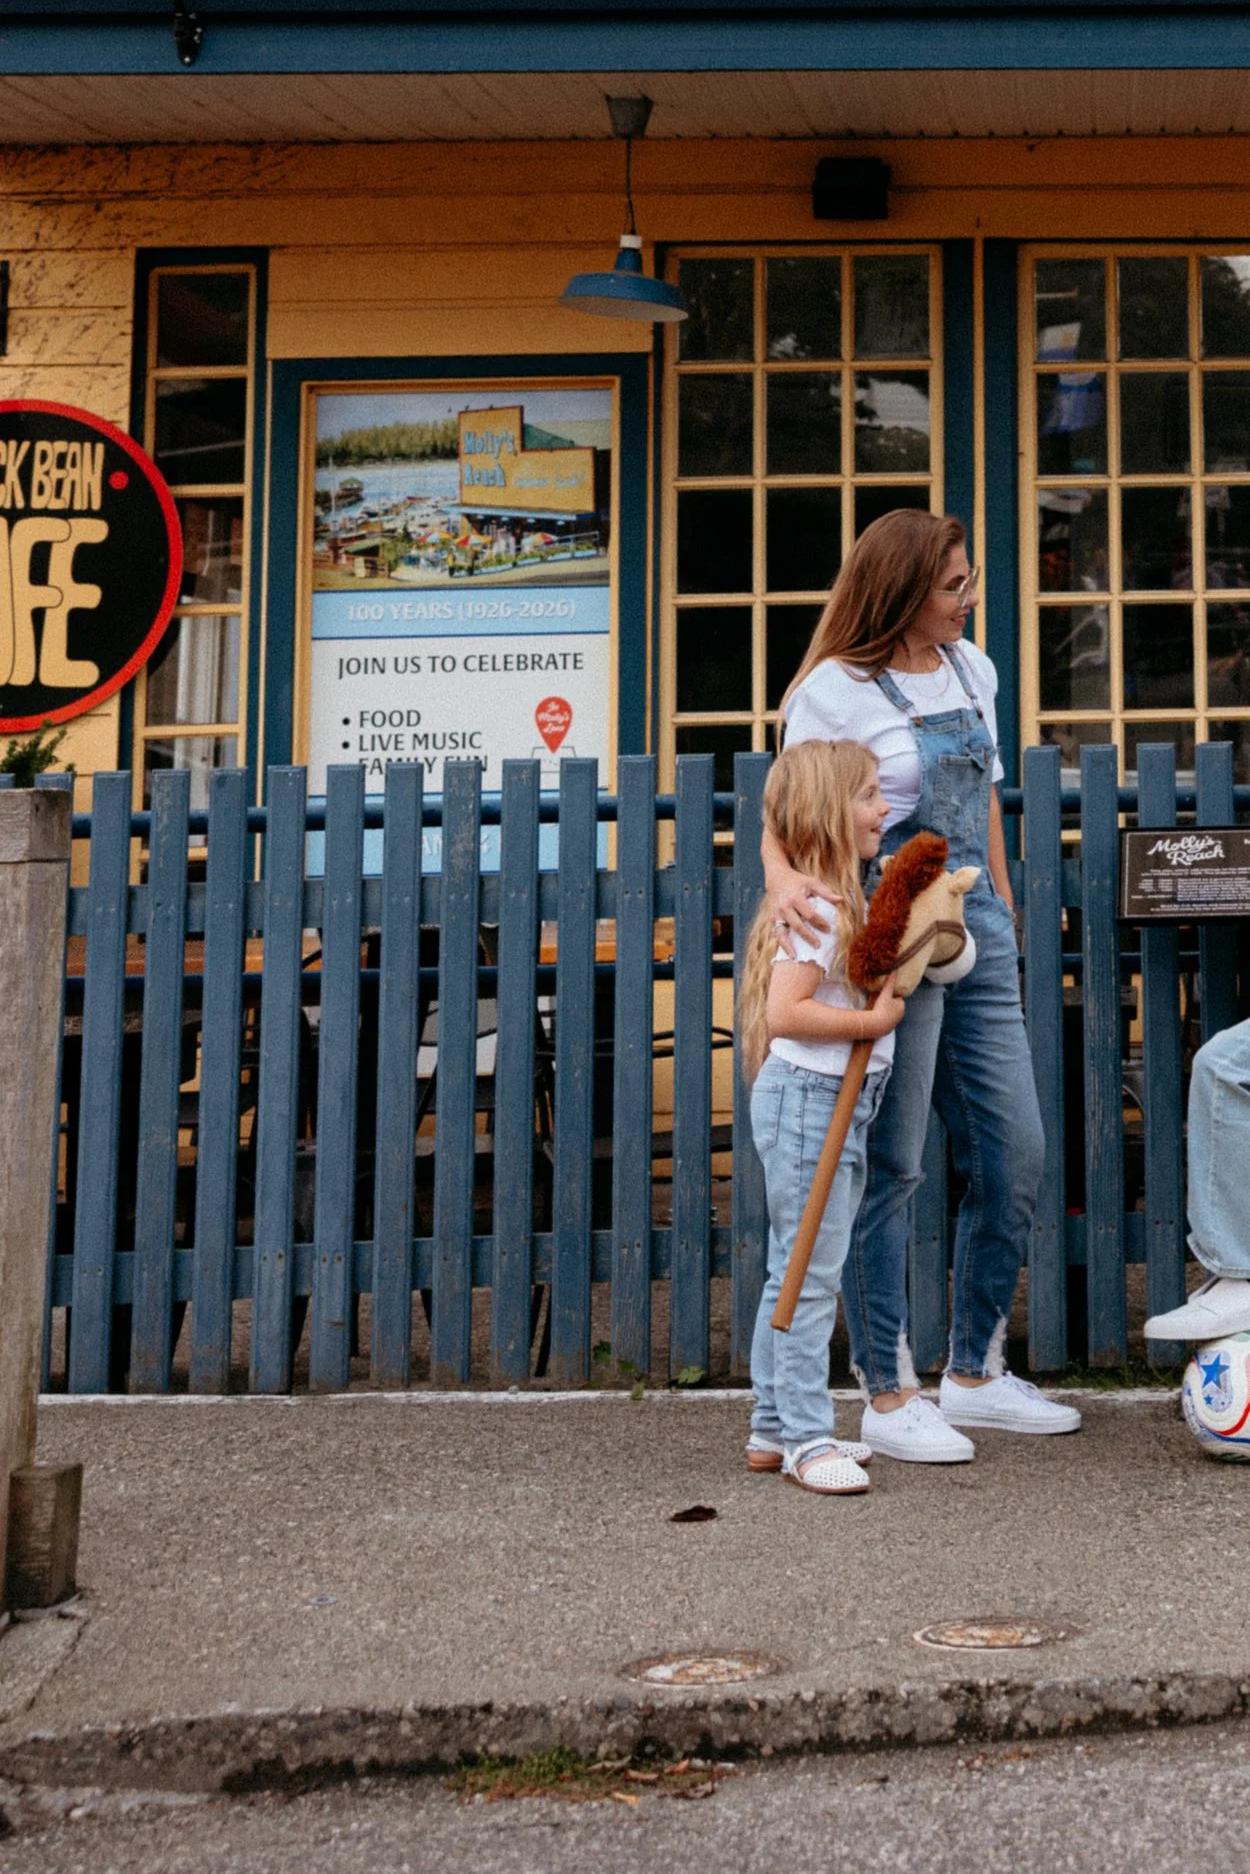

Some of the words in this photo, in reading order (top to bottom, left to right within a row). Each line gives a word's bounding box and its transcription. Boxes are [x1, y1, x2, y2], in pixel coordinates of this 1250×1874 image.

[30, 440, 105, 511] BEAN
[349, 605, 384, 622] 100
[390, 601, 454, 621] YEARS
[458, 597, 577, 621] (1926-2026)
[338, 657, 387, 679] JOIN
[394, 656, 421, 674] US
[427, 655, 457, 673] TO
[463, 653, 584, 672] CELEBRATE
[359, 709, 422, 728] FOOD
[359, 734, 405, 752] LIVE
[413, 732, 483, 750] MUSIC
[1147, 835, 1223, 856] Molly's
[1166, 844, 1226, 866] Reach
